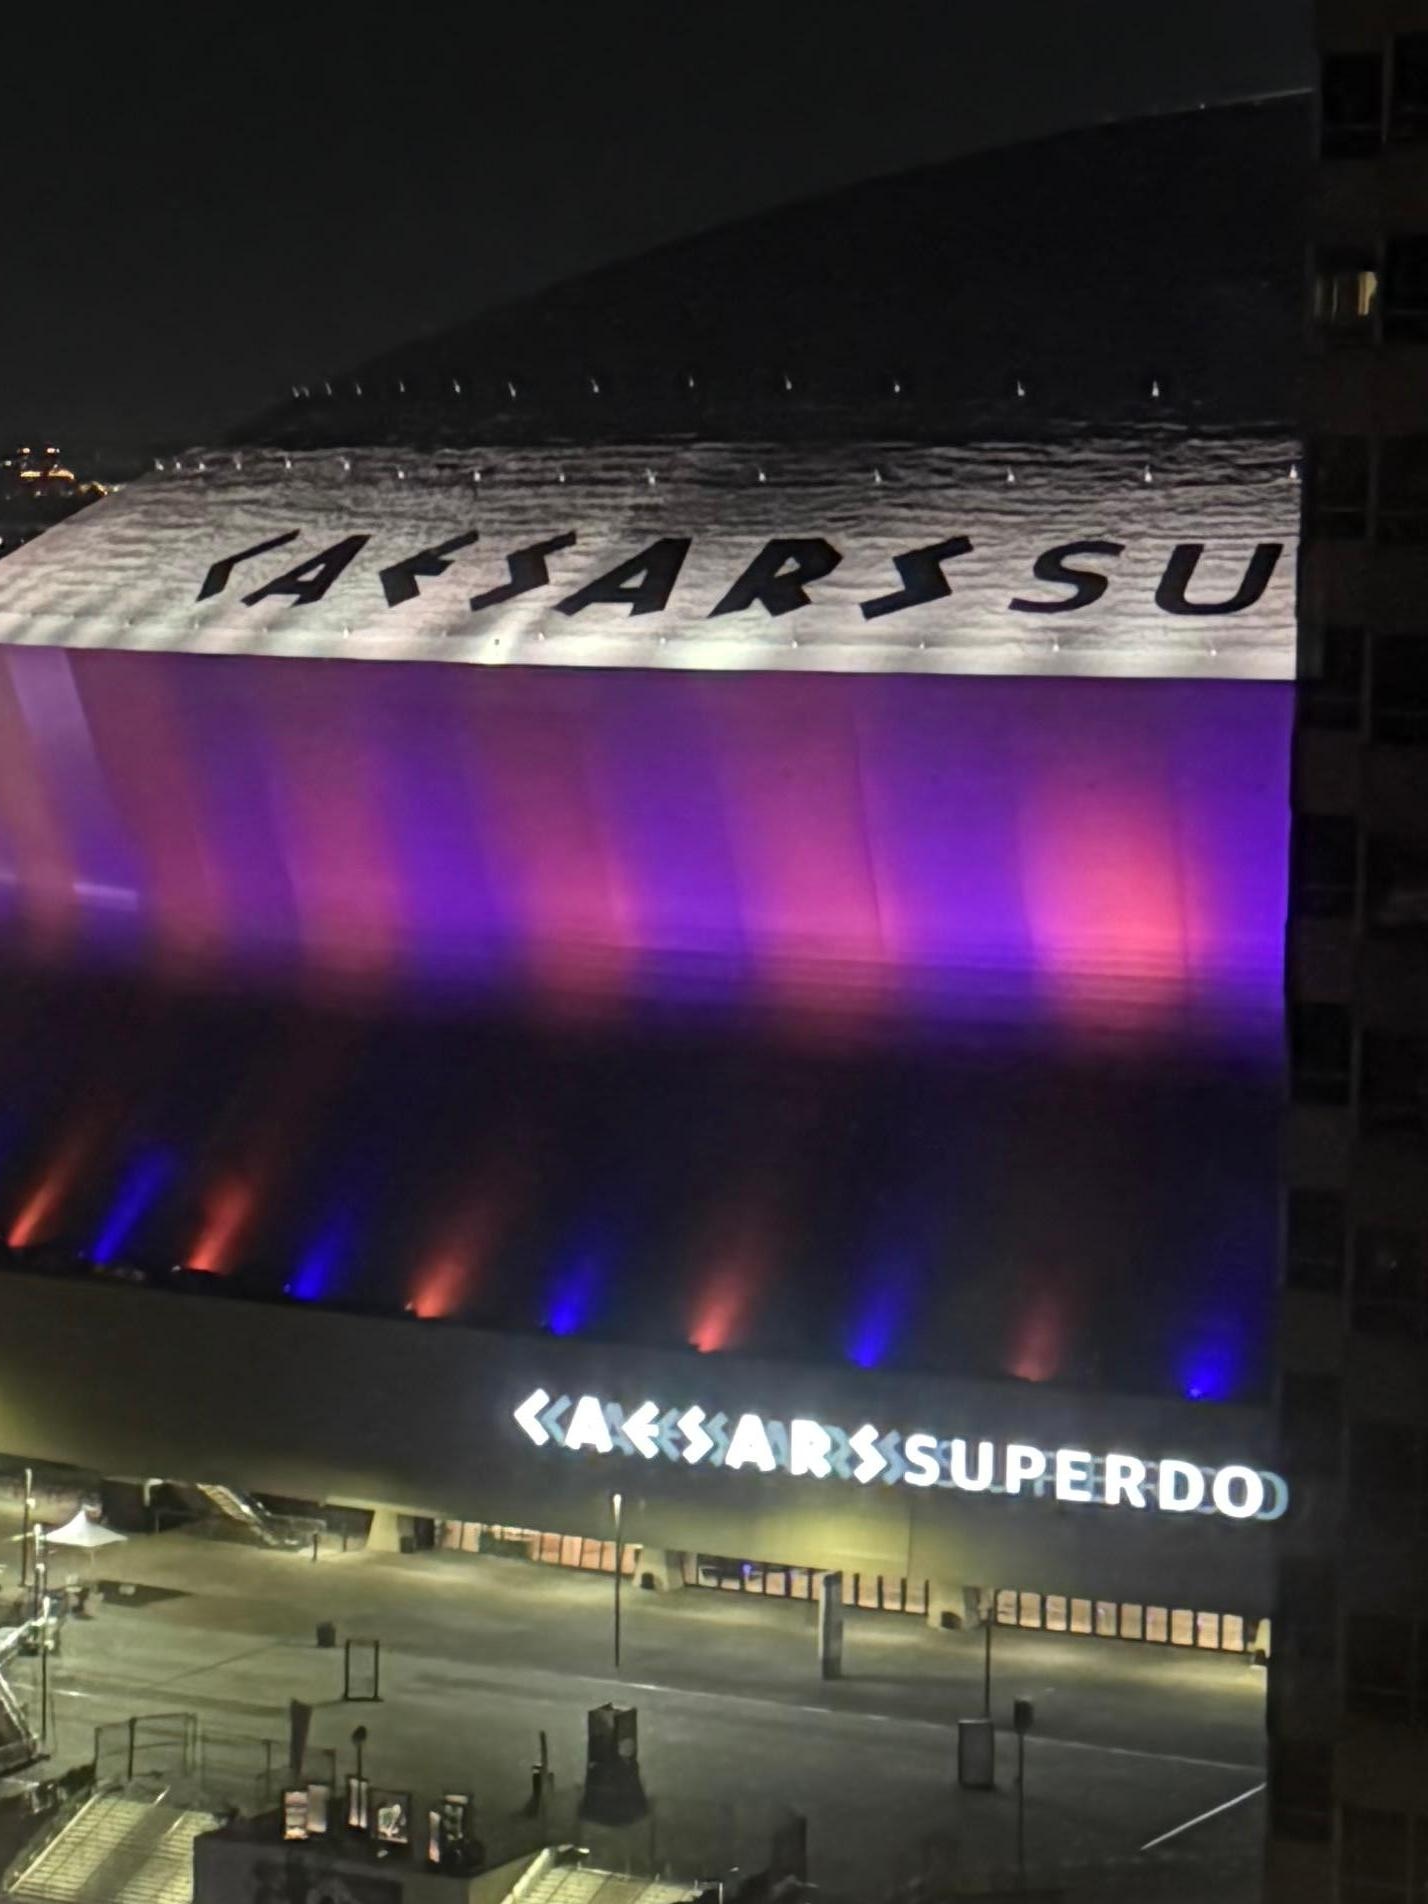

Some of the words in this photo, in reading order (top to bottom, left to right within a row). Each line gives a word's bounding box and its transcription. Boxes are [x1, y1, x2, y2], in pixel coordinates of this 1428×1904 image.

[196, 529, 975, 620] CAESARS
[1008, 541, 1284, 615] SU
[513, 1388, 888, 1486] CAESARS
[903, 1432, 1266, 1519] SUPERDO
